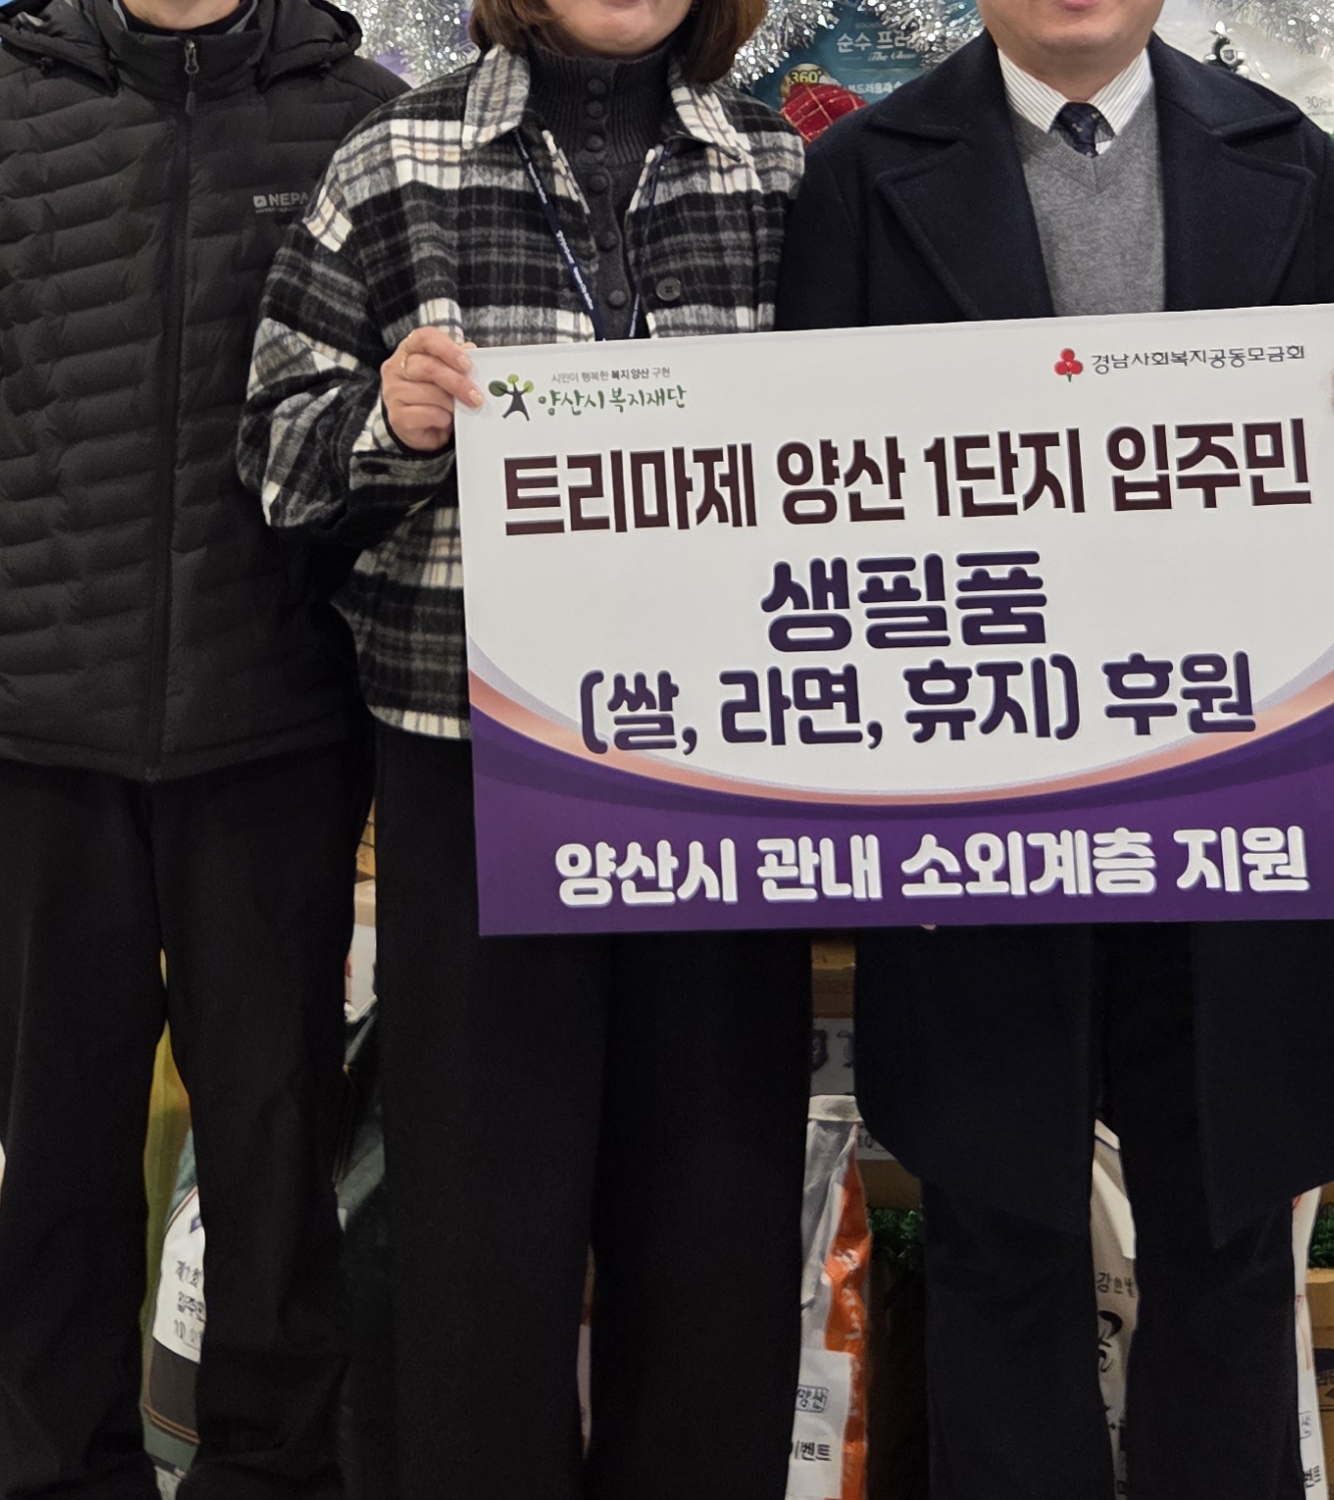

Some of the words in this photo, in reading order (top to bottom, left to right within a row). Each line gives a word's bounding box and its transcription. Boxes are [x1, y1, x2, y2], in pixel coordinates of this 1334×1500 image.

[836, 31, 872, 54] 순수
[1091, 345, 1305, 375] 경남사회복지공동모금회
[503, 442, 759, 536] 트리마제
[776, 436, 907, 526] 양산
[923, 428, 1087, 519] 1단지
[1106, 417, 1313, 515] 입주민
[760, 549, 1048, 654] 생필품
[579, 668, 699, 757] (쌀,
[718, 660, 884, 751] 라면,
[902, 652, 1081, 745] 휴지)
[1101, 650, 1257, 738] 후원
[553, 838, 739, 910] 양산시
[755, 832, 881, 904] 관내
[900, 829, 1156, 898] 소외계층
[1171, 824, 1310, 895] 지원
